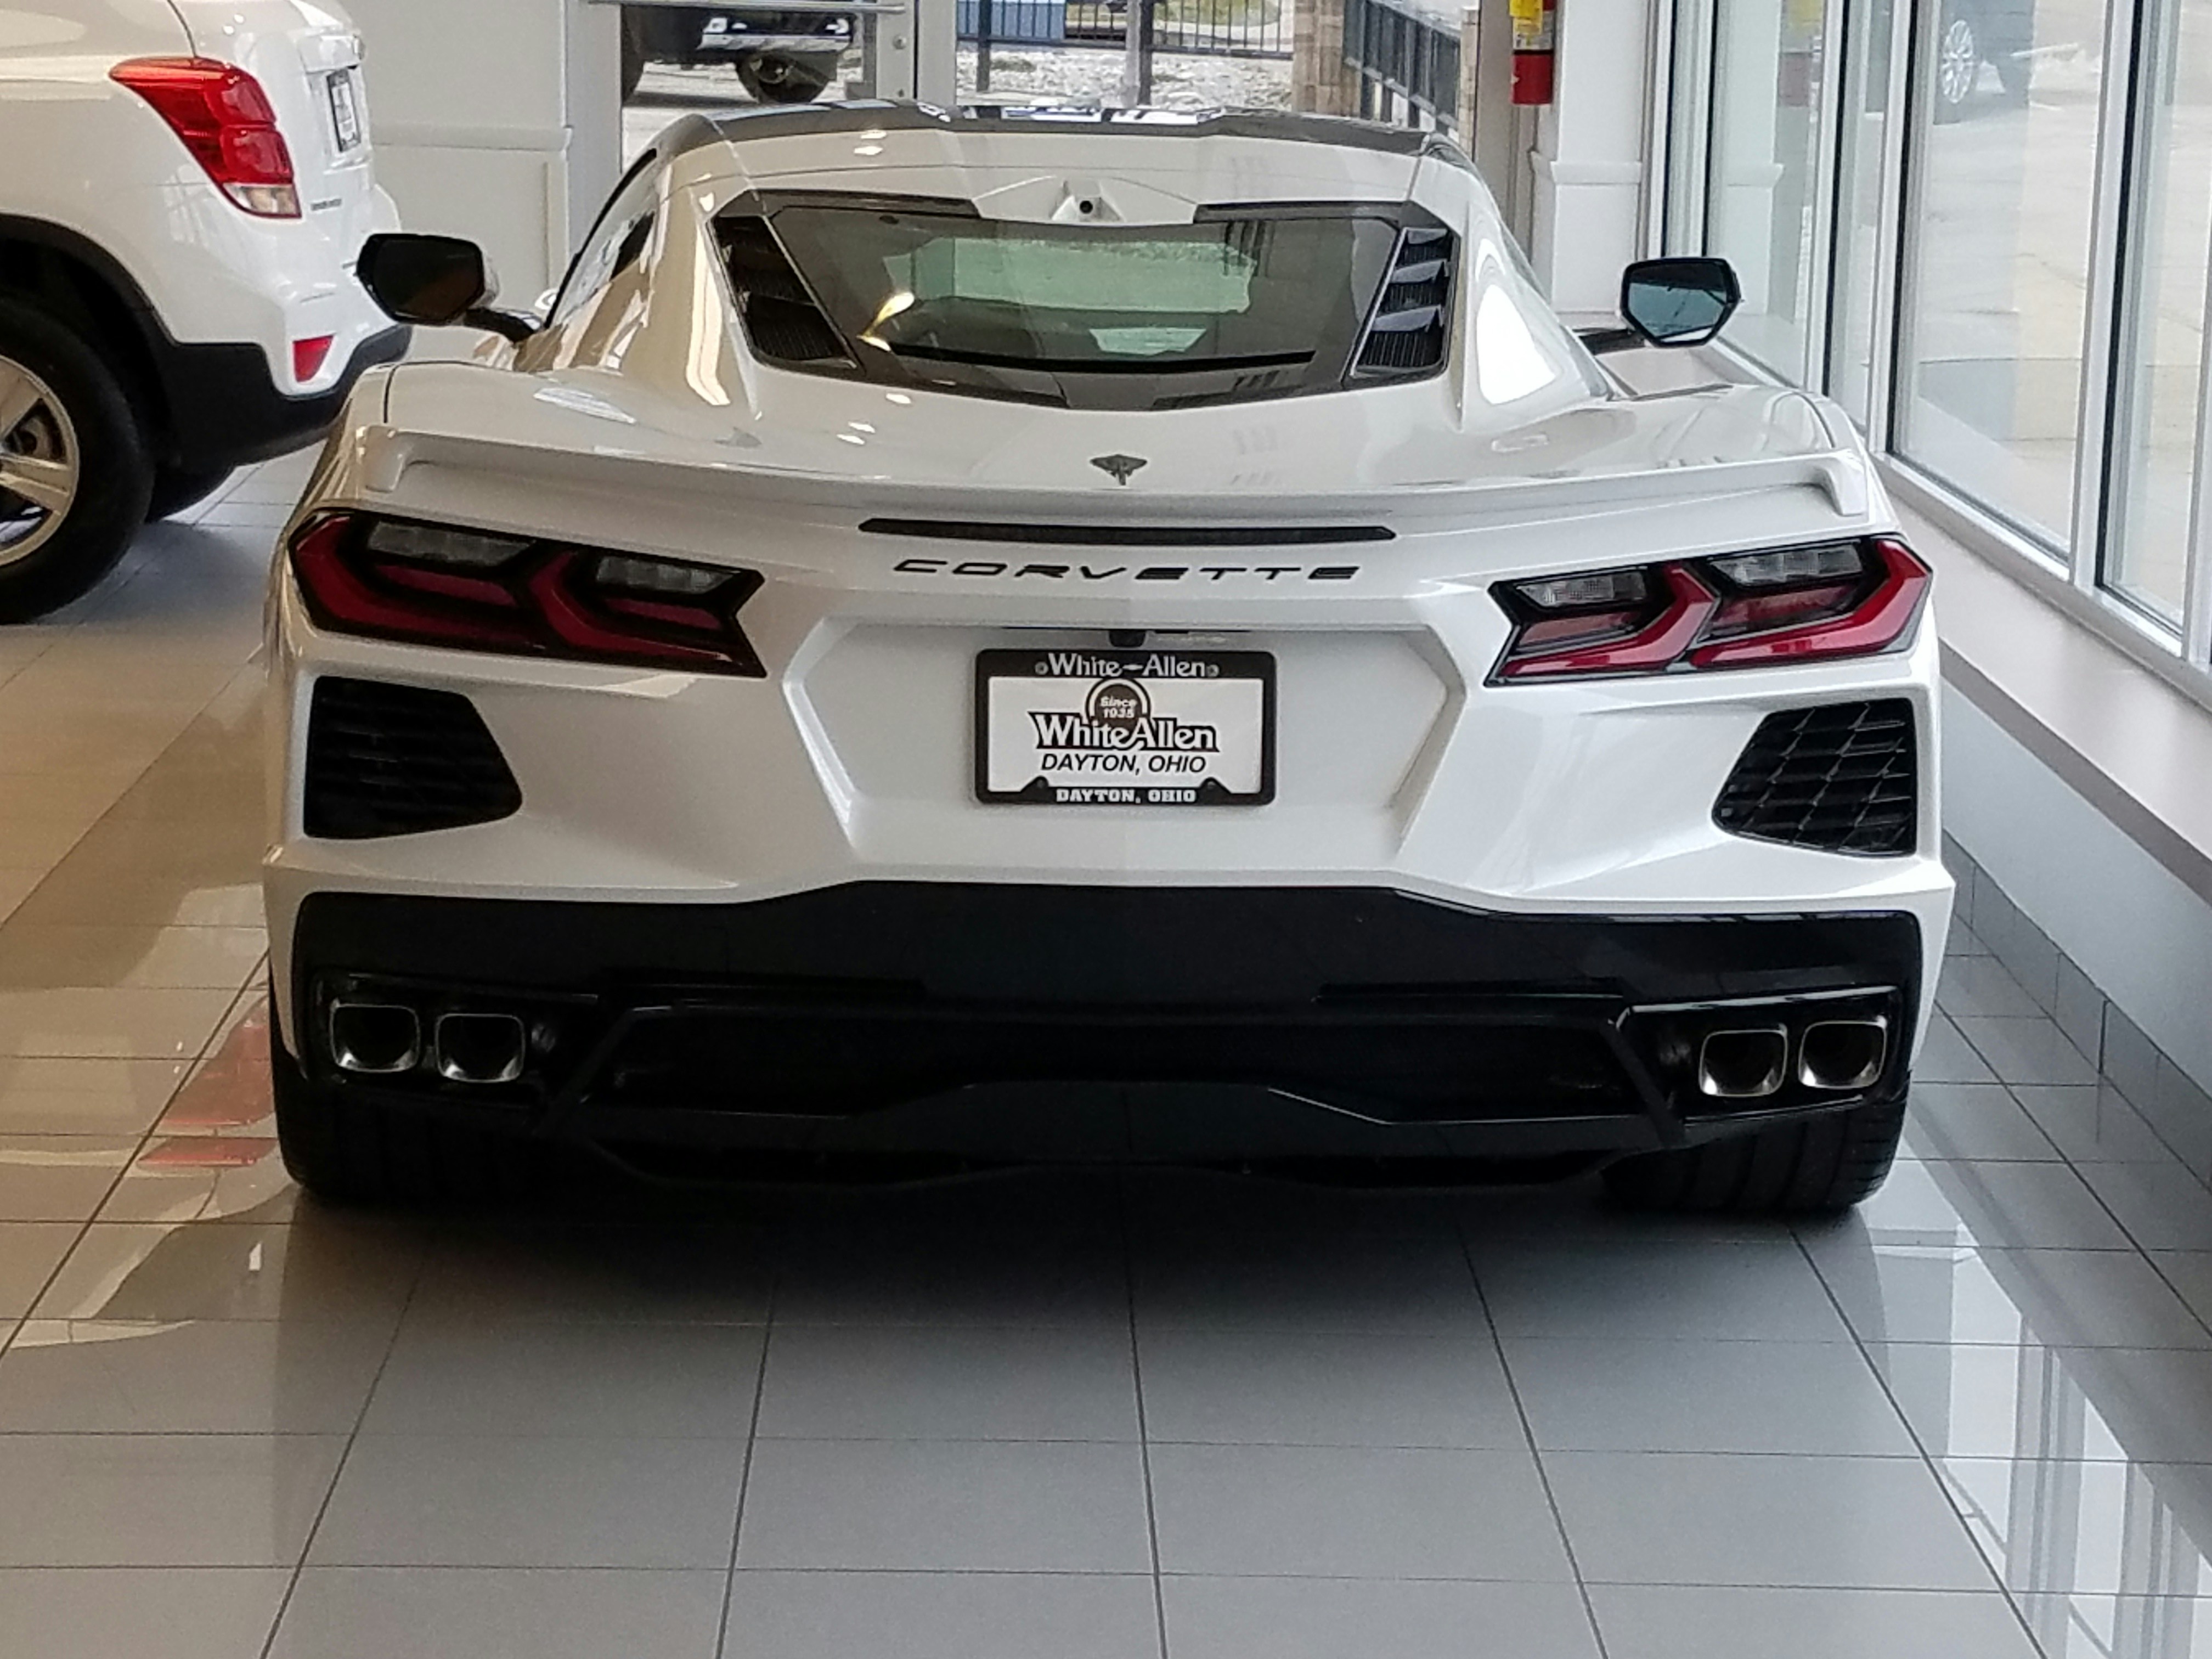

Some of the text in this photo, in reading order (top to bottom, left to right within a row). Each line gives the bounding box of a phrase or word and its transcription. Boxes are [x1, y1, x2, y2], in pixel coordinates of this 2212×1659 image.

[894, 558, 1360, 580] CORVETTE
[1042, 753, 1206, 775] DAYTON, OHIO
[1148, 789, 1197, 803] OHIO
